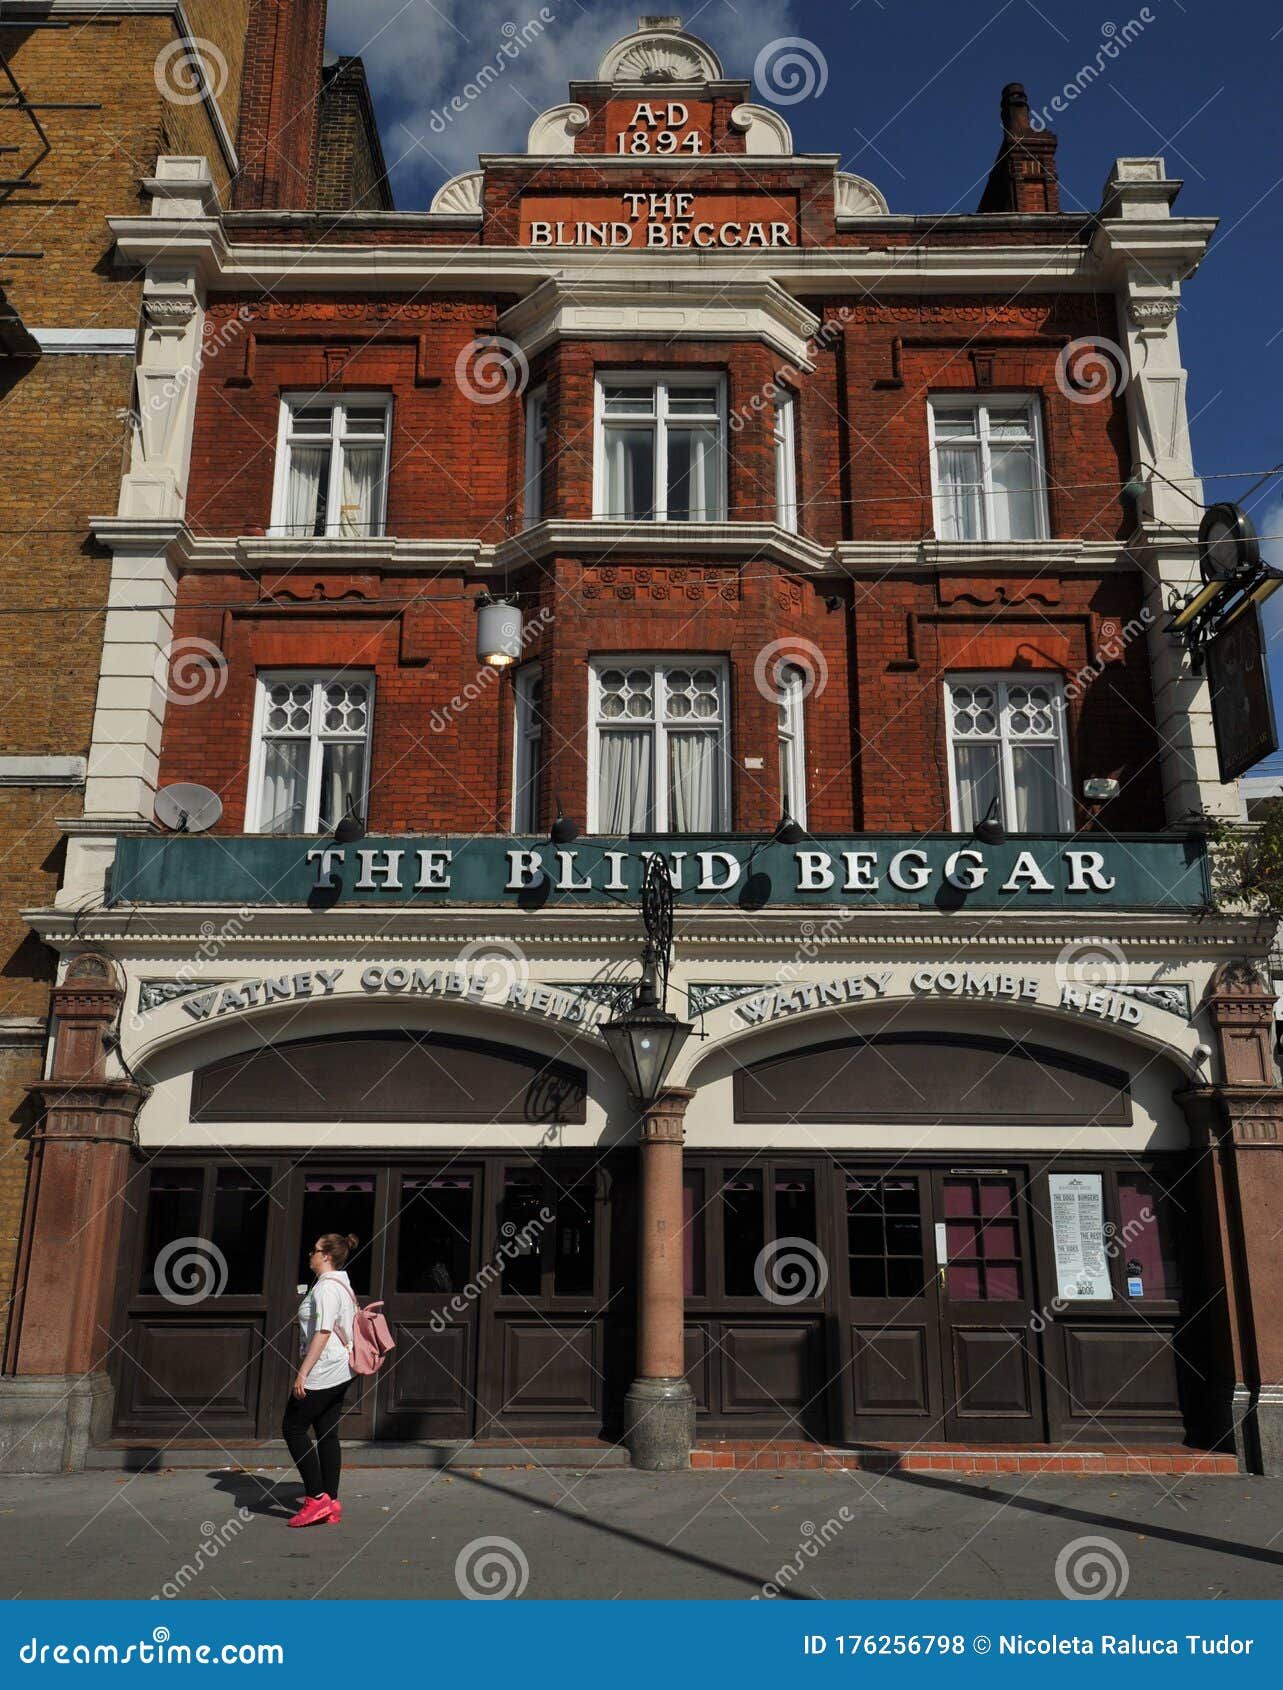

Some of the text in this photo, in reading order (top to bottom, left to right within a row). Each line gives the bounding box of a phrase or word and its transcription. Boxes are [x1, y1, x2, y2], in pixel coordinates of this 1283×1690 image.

[617, 131, 702, 155] 1894
[624, 193, 695, 218] THE
[531, 222, 633, 247] BLIND
[307, 849, 1116, 891] THE BLIND BEGGAR
[183, 966, 585, 1021] WATNEY COMBE REID
[739, 970, 1144, 1024] WATNEY COMBE REID
